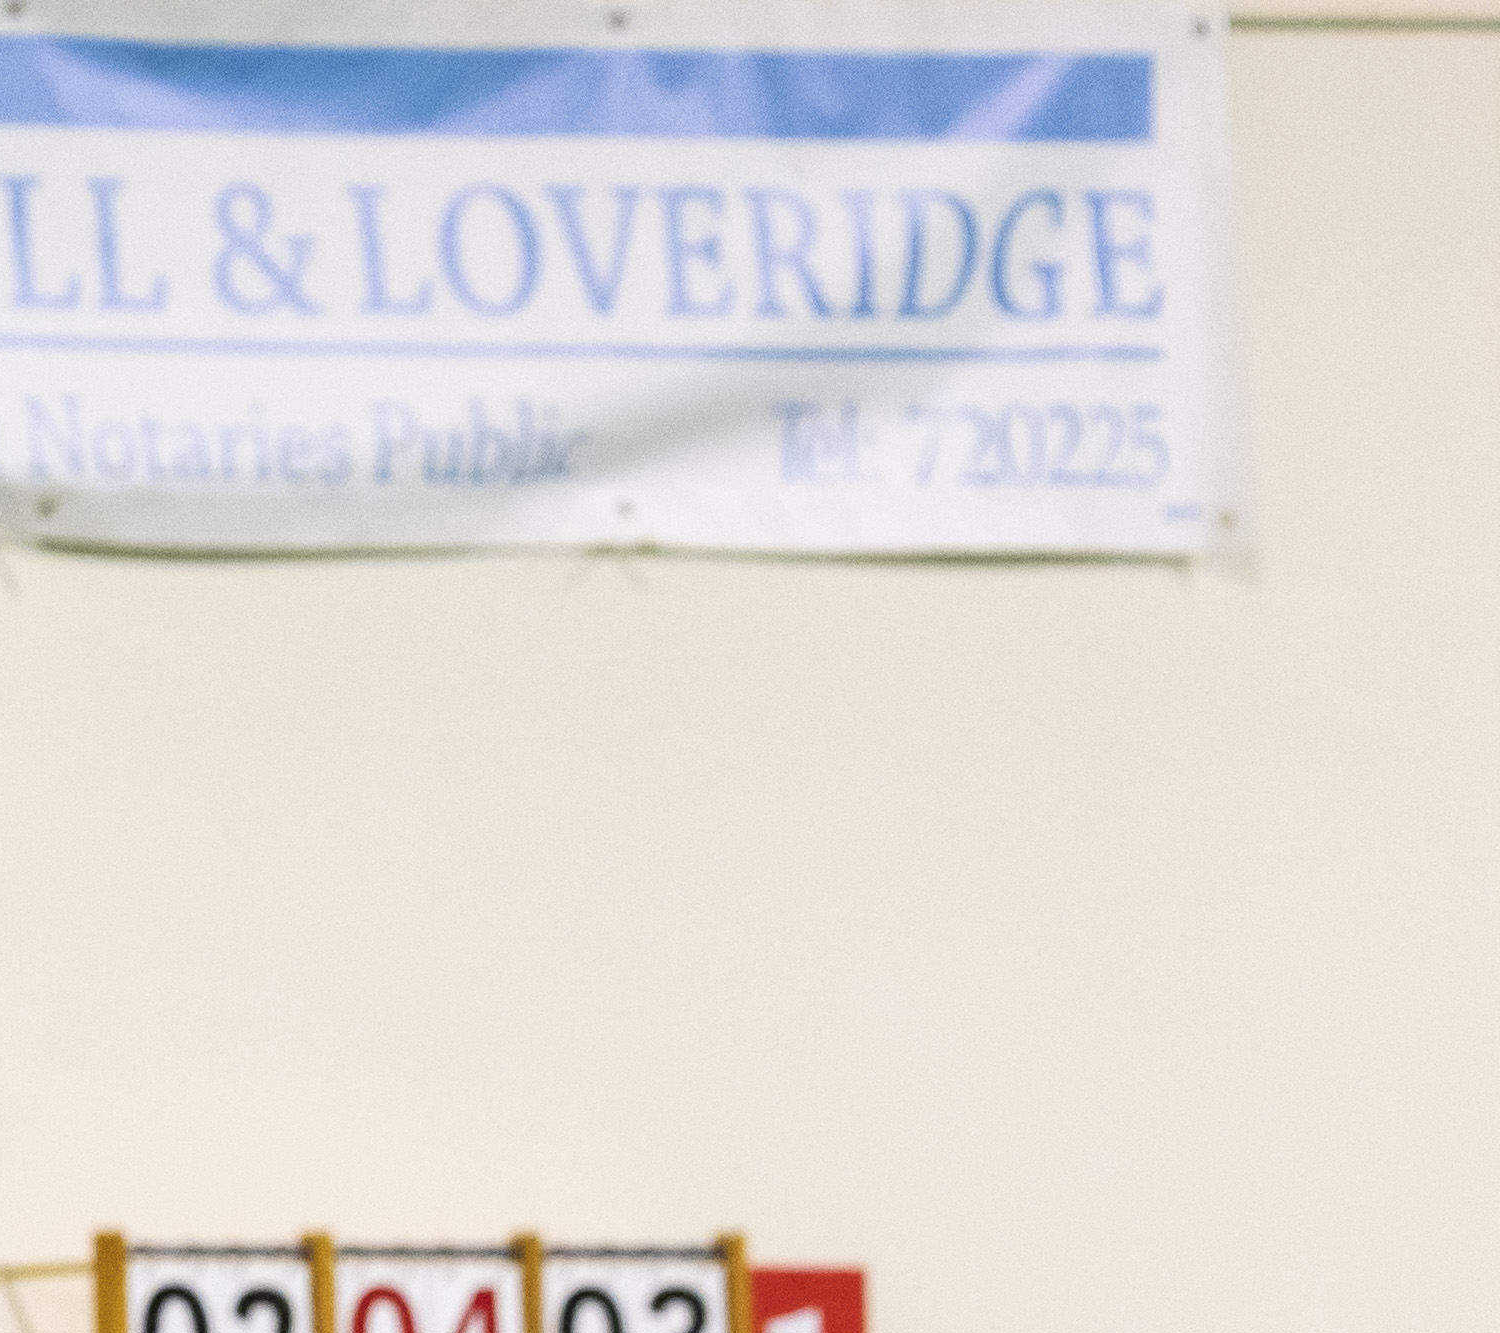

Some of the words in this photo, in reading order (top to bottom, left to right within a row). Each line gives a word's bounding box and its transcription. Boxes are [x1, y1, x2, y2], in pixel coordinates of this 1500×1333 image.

[211, 181, 325, 317] &
[346, 181, 1166, 321] LOVERIDGE
[23, 391, 353, 485] Notaries
[373, 396, 594, 486] Public
[904, 402, 1170, 488] 720225
